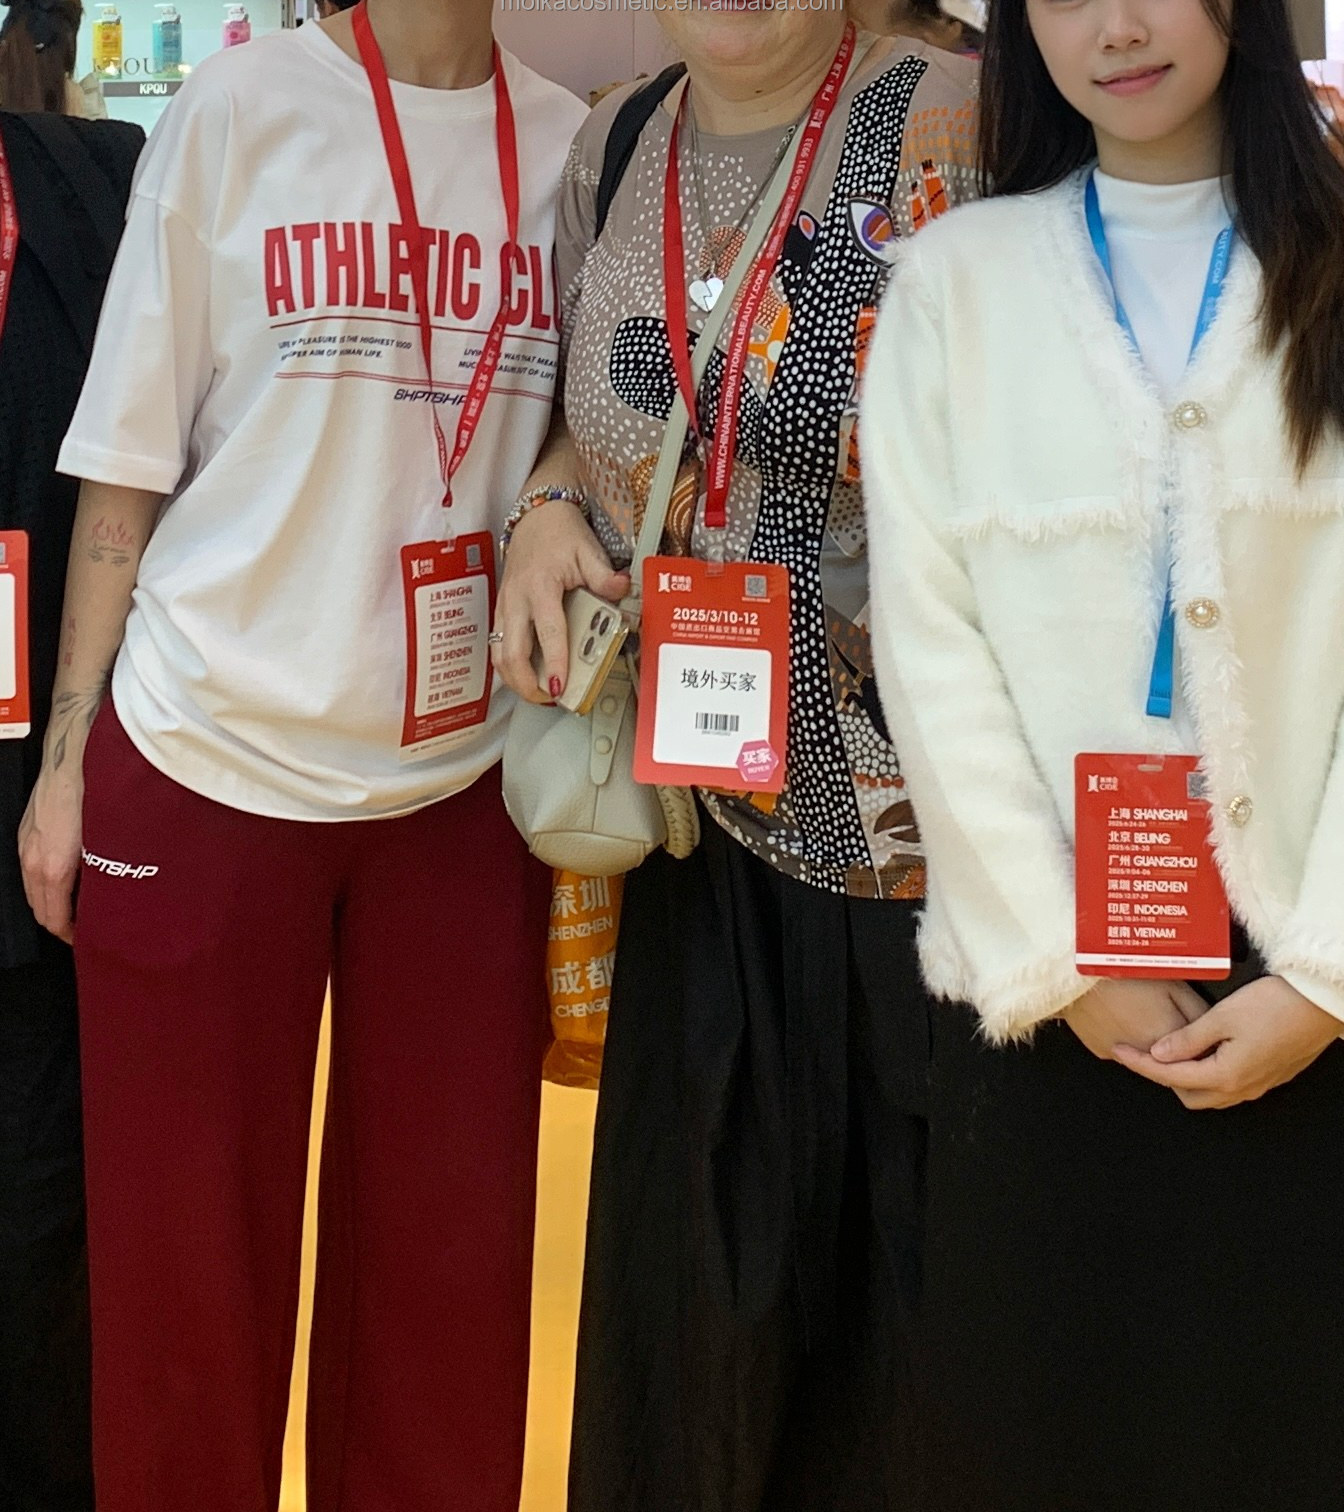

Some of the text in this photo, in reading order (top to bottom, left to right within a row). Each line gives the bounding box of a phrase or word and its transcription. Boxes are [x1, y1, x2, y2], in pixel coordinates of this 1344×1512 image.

[140, 83, 168, 95] KPQU
[715, 269, 767, 490] WWW.CHINAINTERNATIONALBEAUTY.COM
[673, 607, 759, 625] 2025/3/10-12
[681, 668, 757, 692] 境外买家
[742, 750, 773, 766] 买家
[1108, 808, 1188, 821] 上海 SHANGHAI
[1108, 831, 1131, 843] 北京
[1108, 855, 1198, 868] 广州 GUANGZHOU
[1133, 880, 1188, 893] SHENZHEN
[551, 876, 611, 918] 深圳
[1107, 903, 1188, 916] 印尼 INDONESIA
[548, 915, 613, 942] SHENZHEN
[1108, 926, 1176, 939] 越南 VIETNAM
[552, 951, 615, 996] 成都
